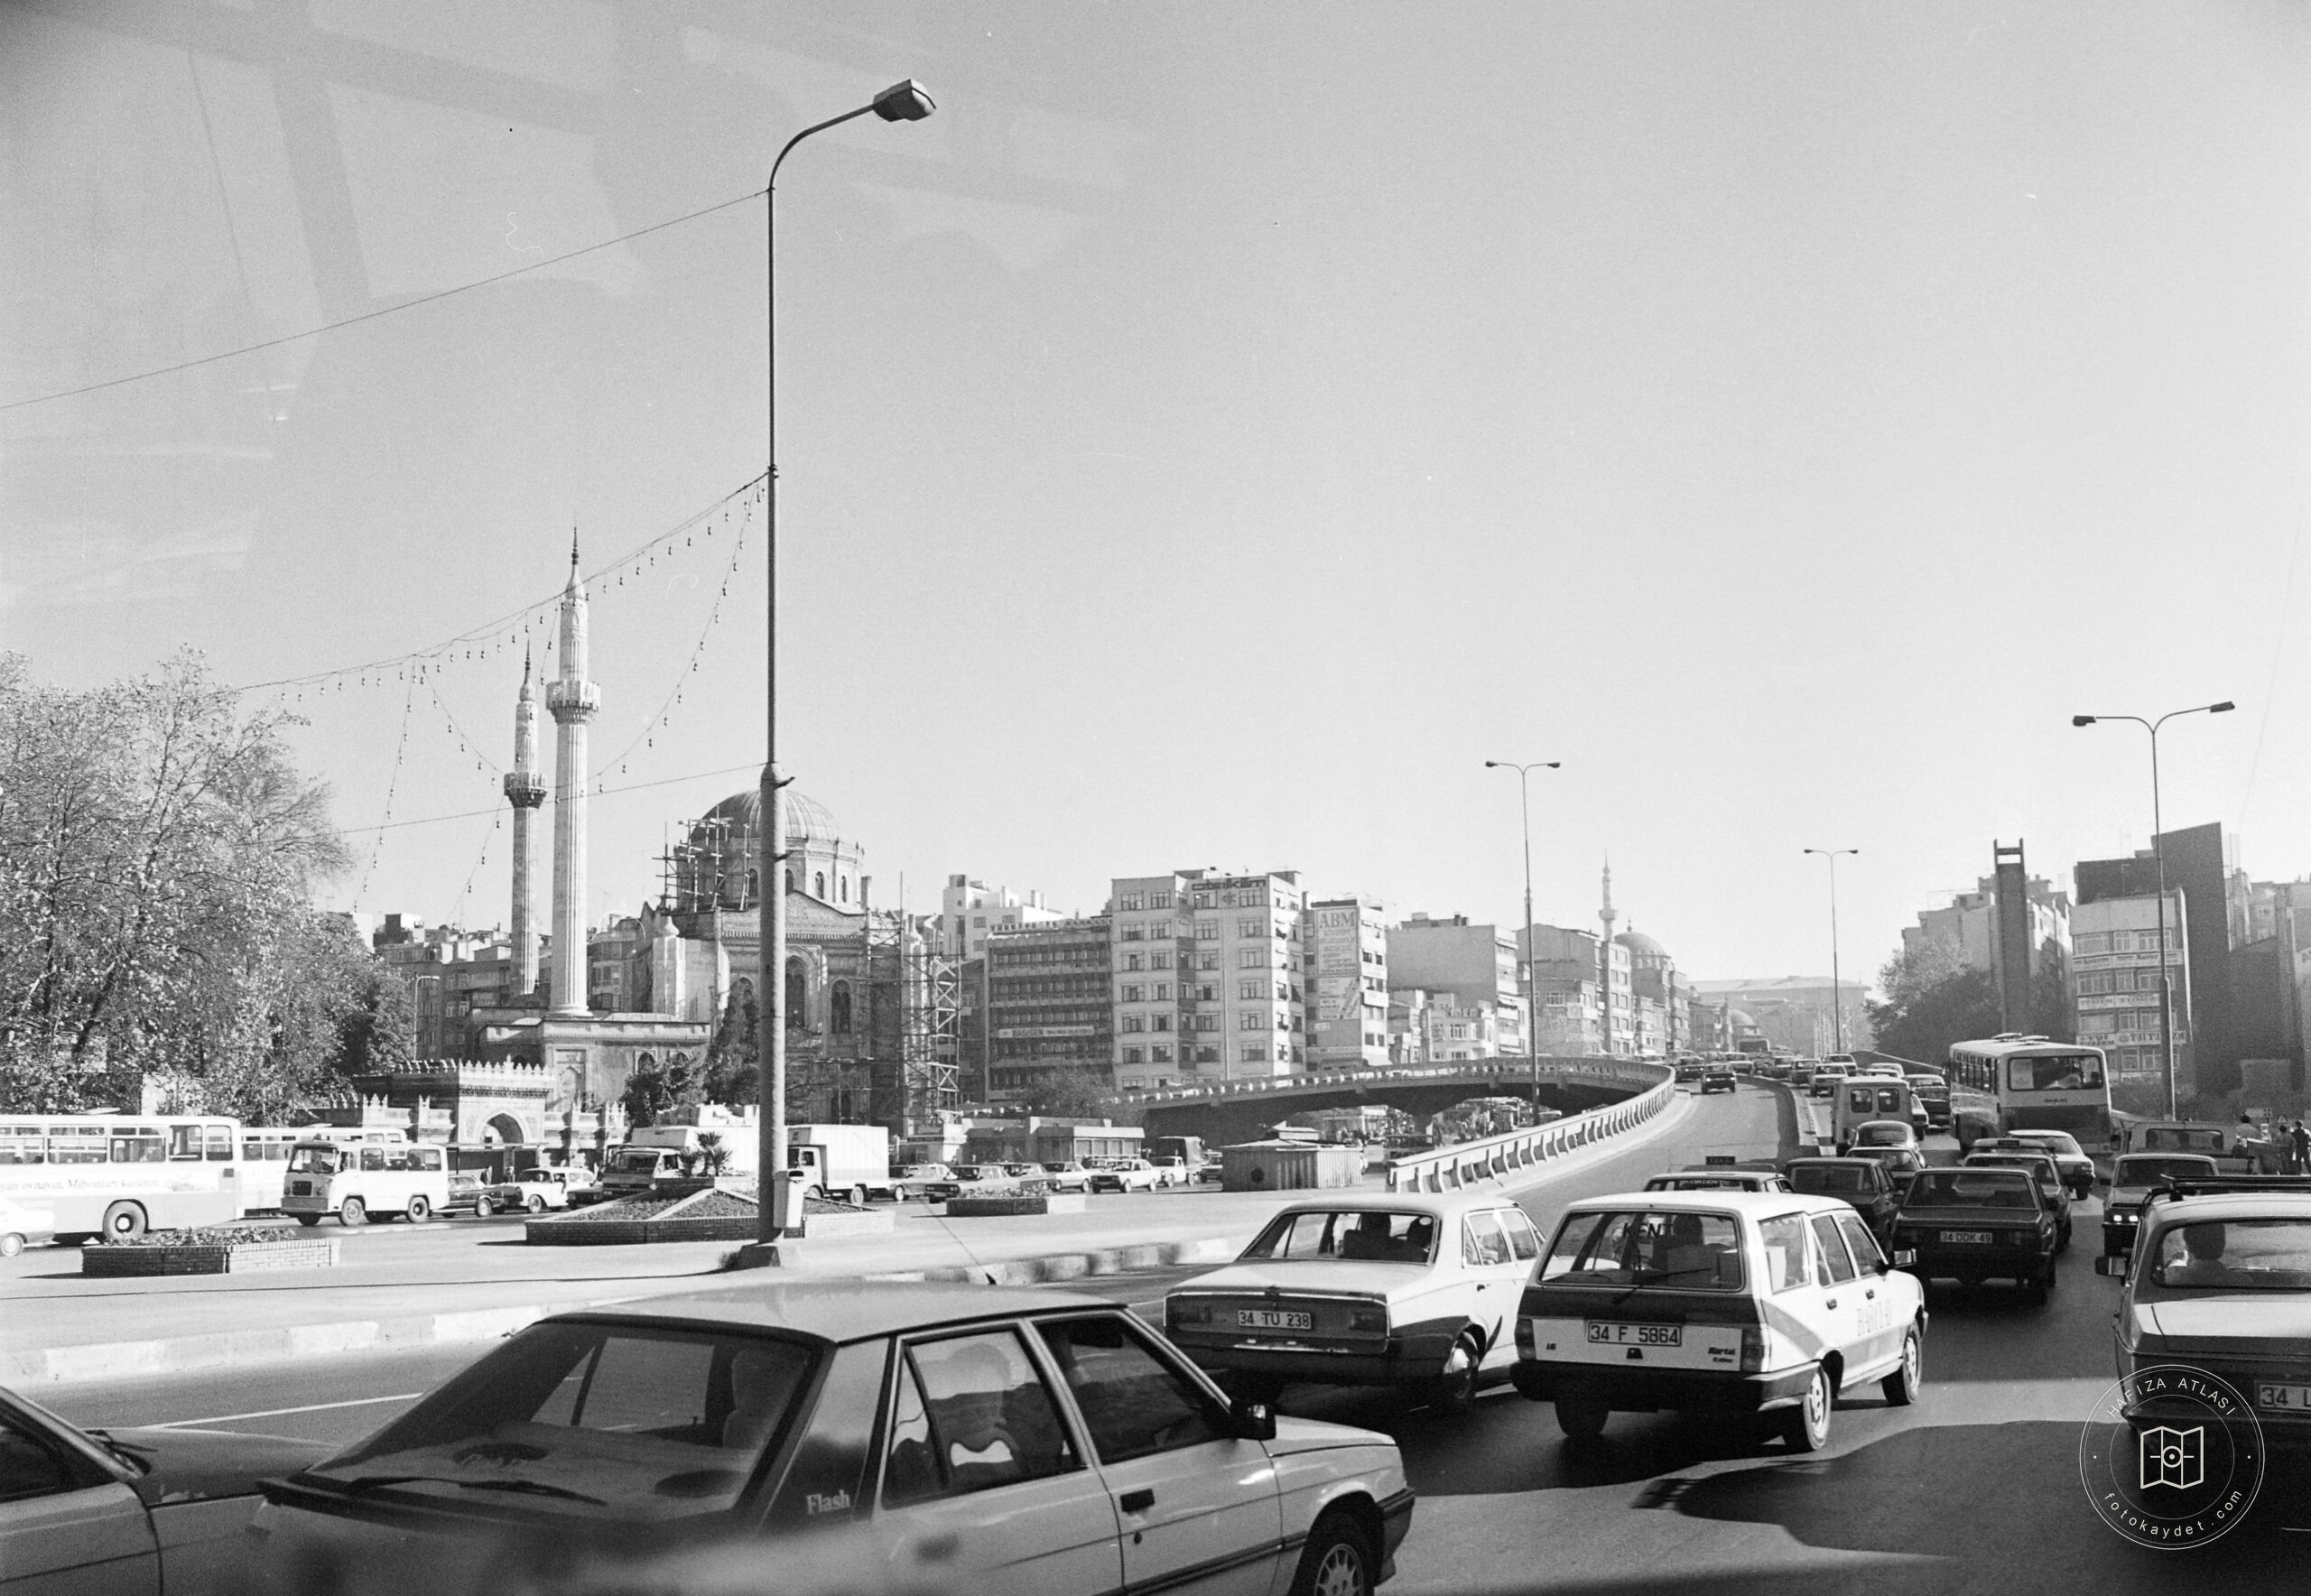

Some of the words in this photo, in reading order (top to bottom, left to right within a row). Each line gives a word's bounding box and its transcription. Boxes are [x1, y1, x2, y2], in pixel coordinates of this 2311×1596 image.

[1320, 911, 1356, 928] ABM
[1622, 1222, 1674, 1239] KENT
[1941, 1232, 1954, 1241] 34
[1239, 1312, 1255, 1325] 34
[1262, 1312, 1280, 1326] TU
[1286, 1313, 1310, 1328] 238
[1591, 1324, 1610, 1341] 34
[1619, 1326, 1629, 1341] F
[1638, 1327, 1679, 1344] 5864
[2261, 1387, 2289, 1407] 34
[806, 1489, 850, 1515] Flash
